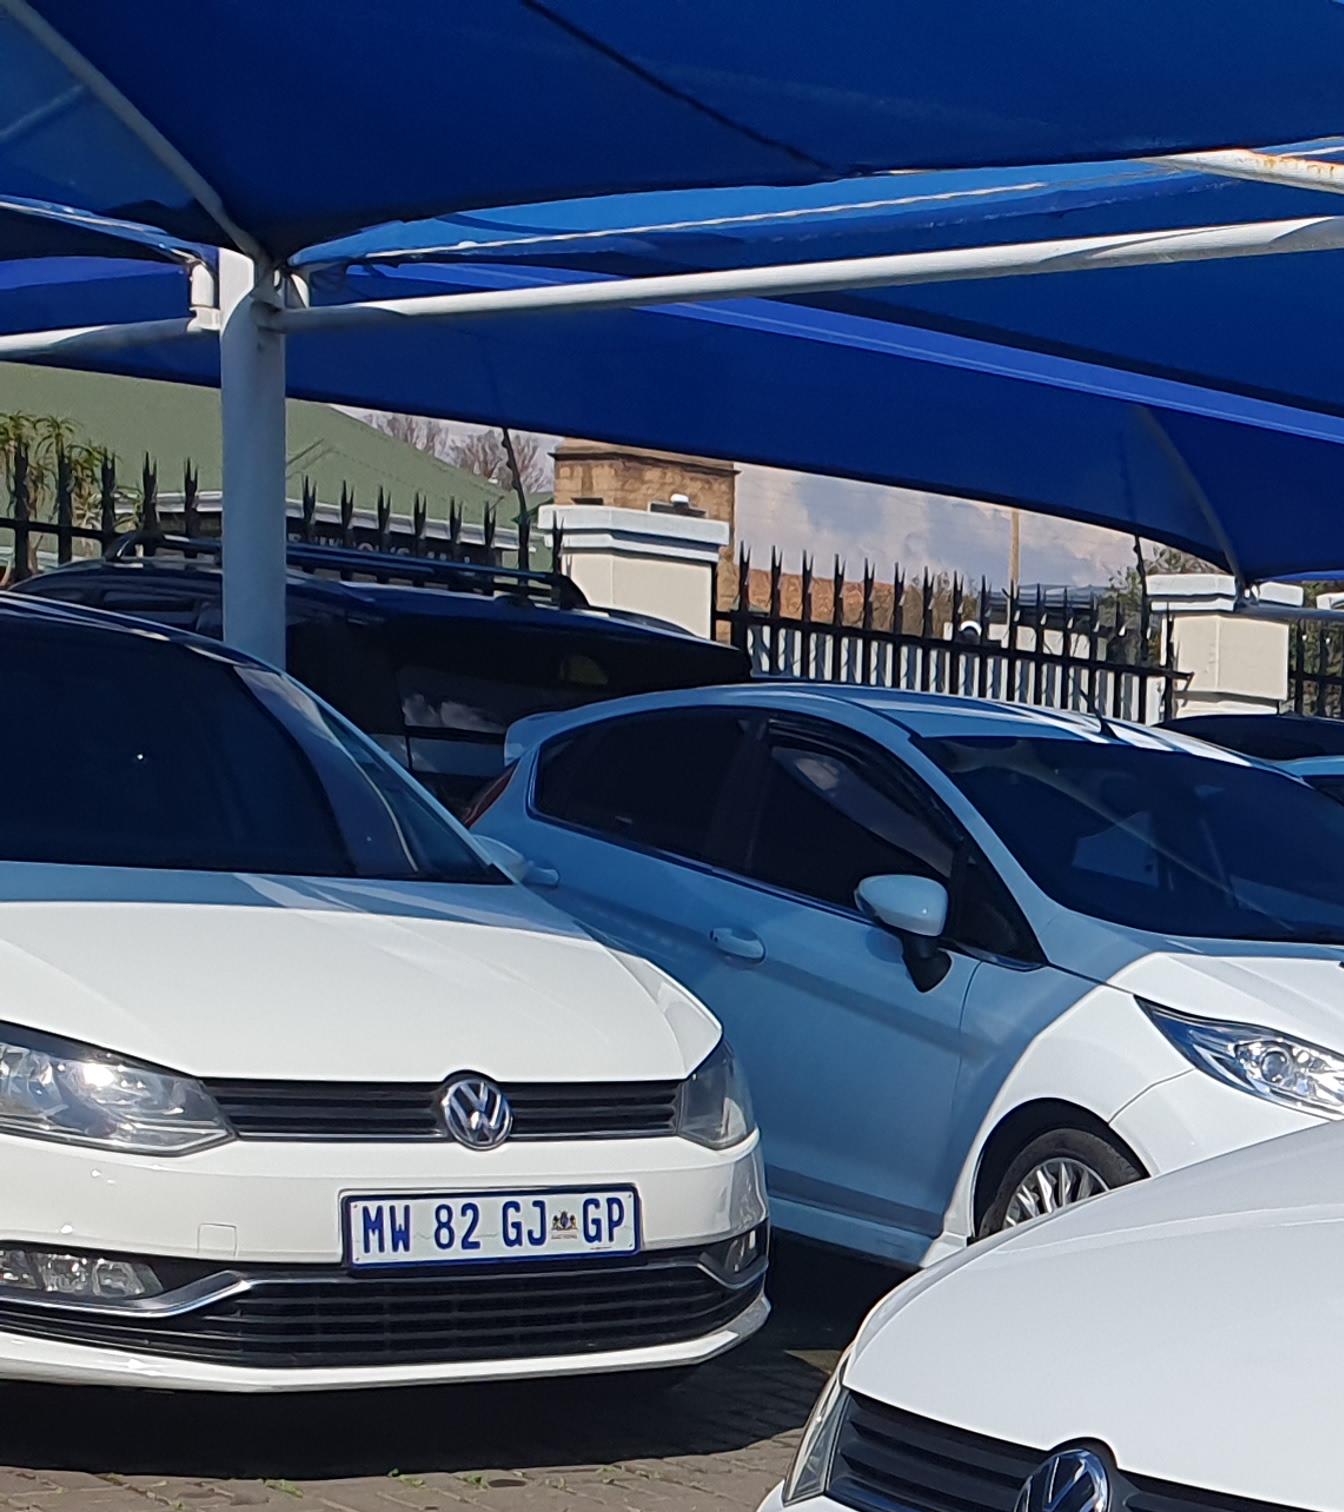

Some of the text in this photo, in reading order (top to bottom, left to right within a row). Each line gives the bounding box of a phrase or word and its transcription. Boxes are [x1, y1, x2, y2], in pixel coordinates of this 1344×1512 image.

[362, 1197, 625, 1254] MW 82 GJ GP
